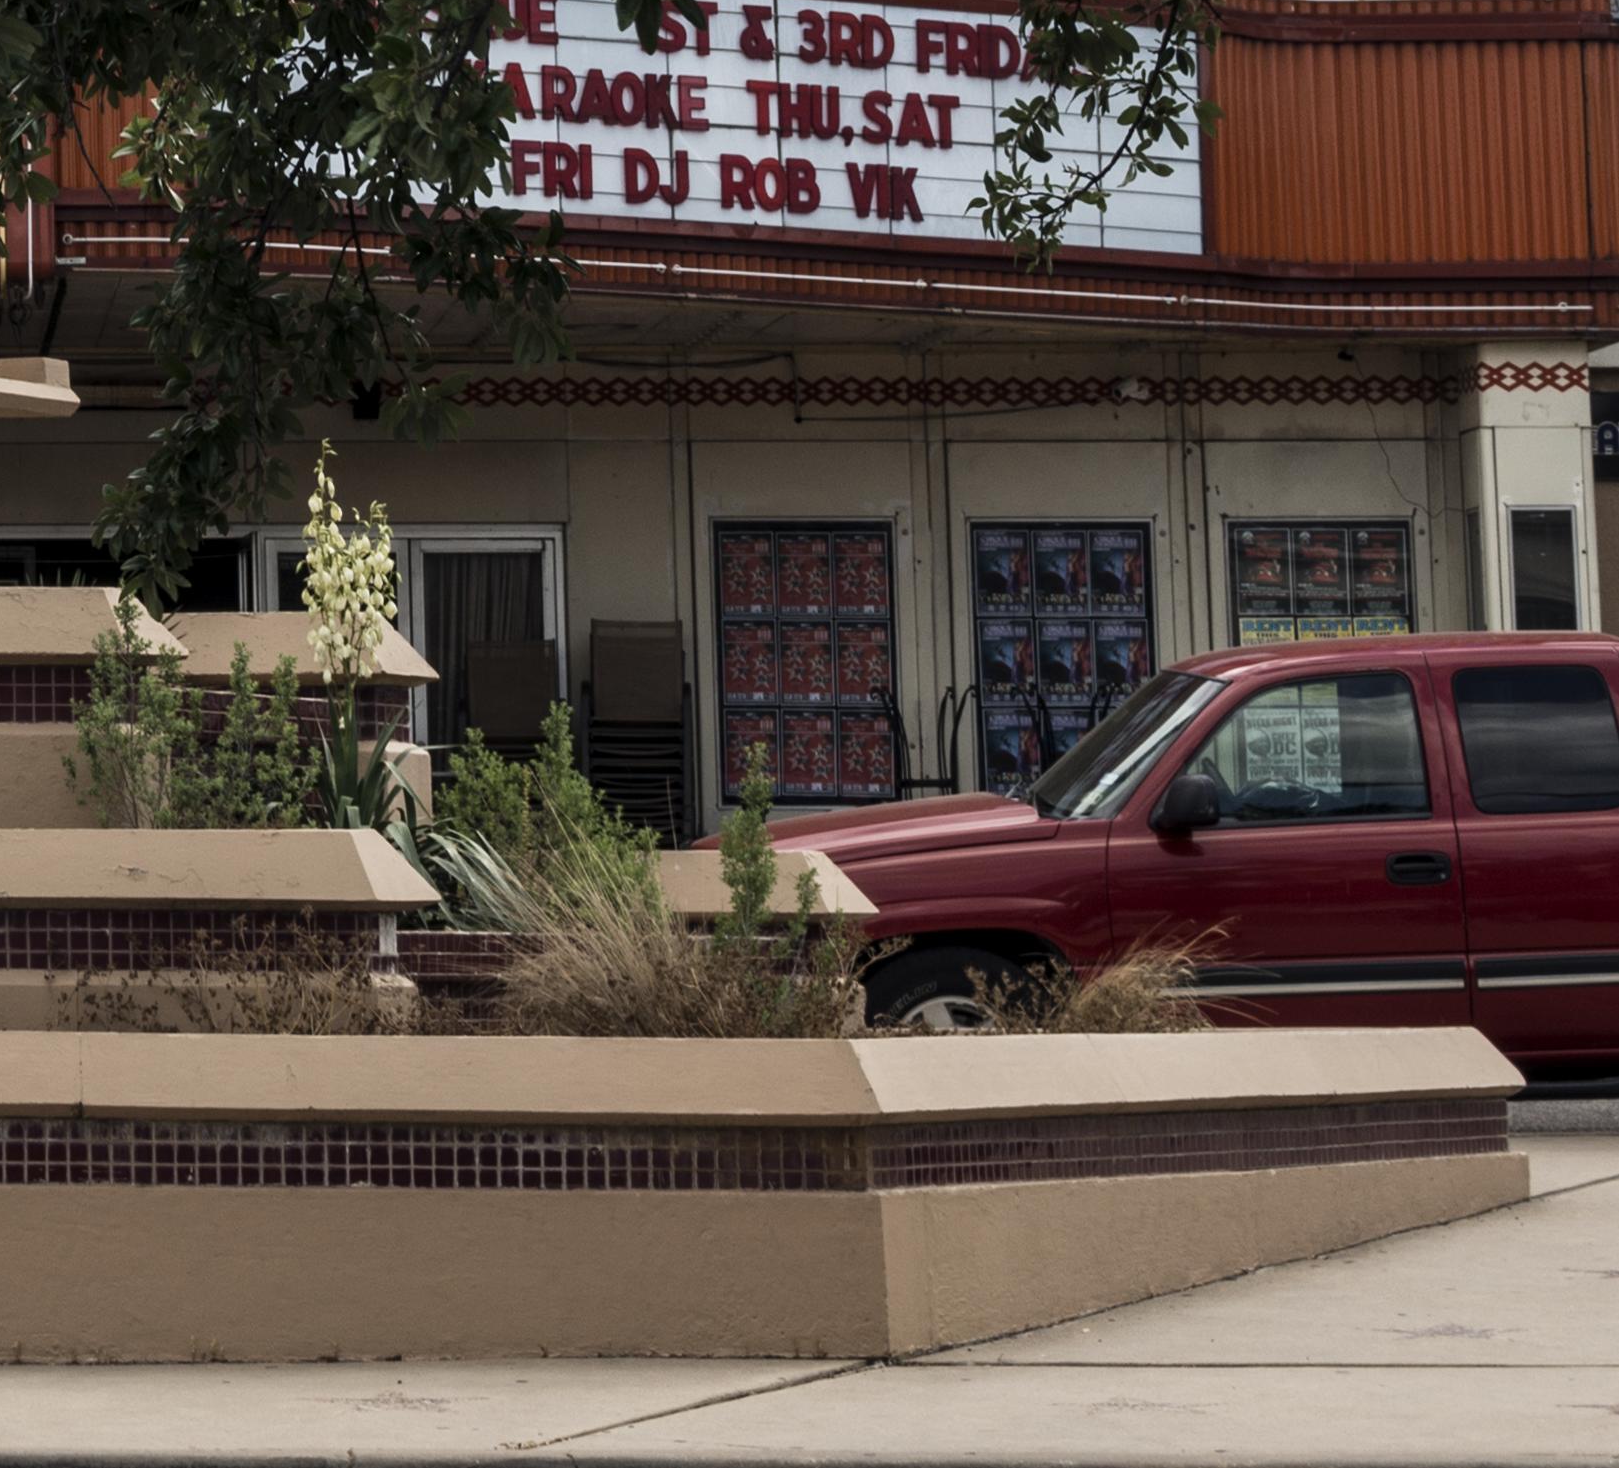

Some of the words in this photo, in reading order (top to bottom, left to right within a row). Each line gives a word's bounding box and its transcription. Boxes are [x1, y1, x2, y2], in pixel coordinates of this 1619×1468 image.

[739, 4, 776, 61] &
[797, 8, 895, 70] 3RD
[465, 58, 710, 132] ARAOKE
[510, 139, 594, 201] FRI
[623, 147, 690, 206] DJ
[720, 152, 822, 215] ROB
[845, 161, 925, 223] VIK
